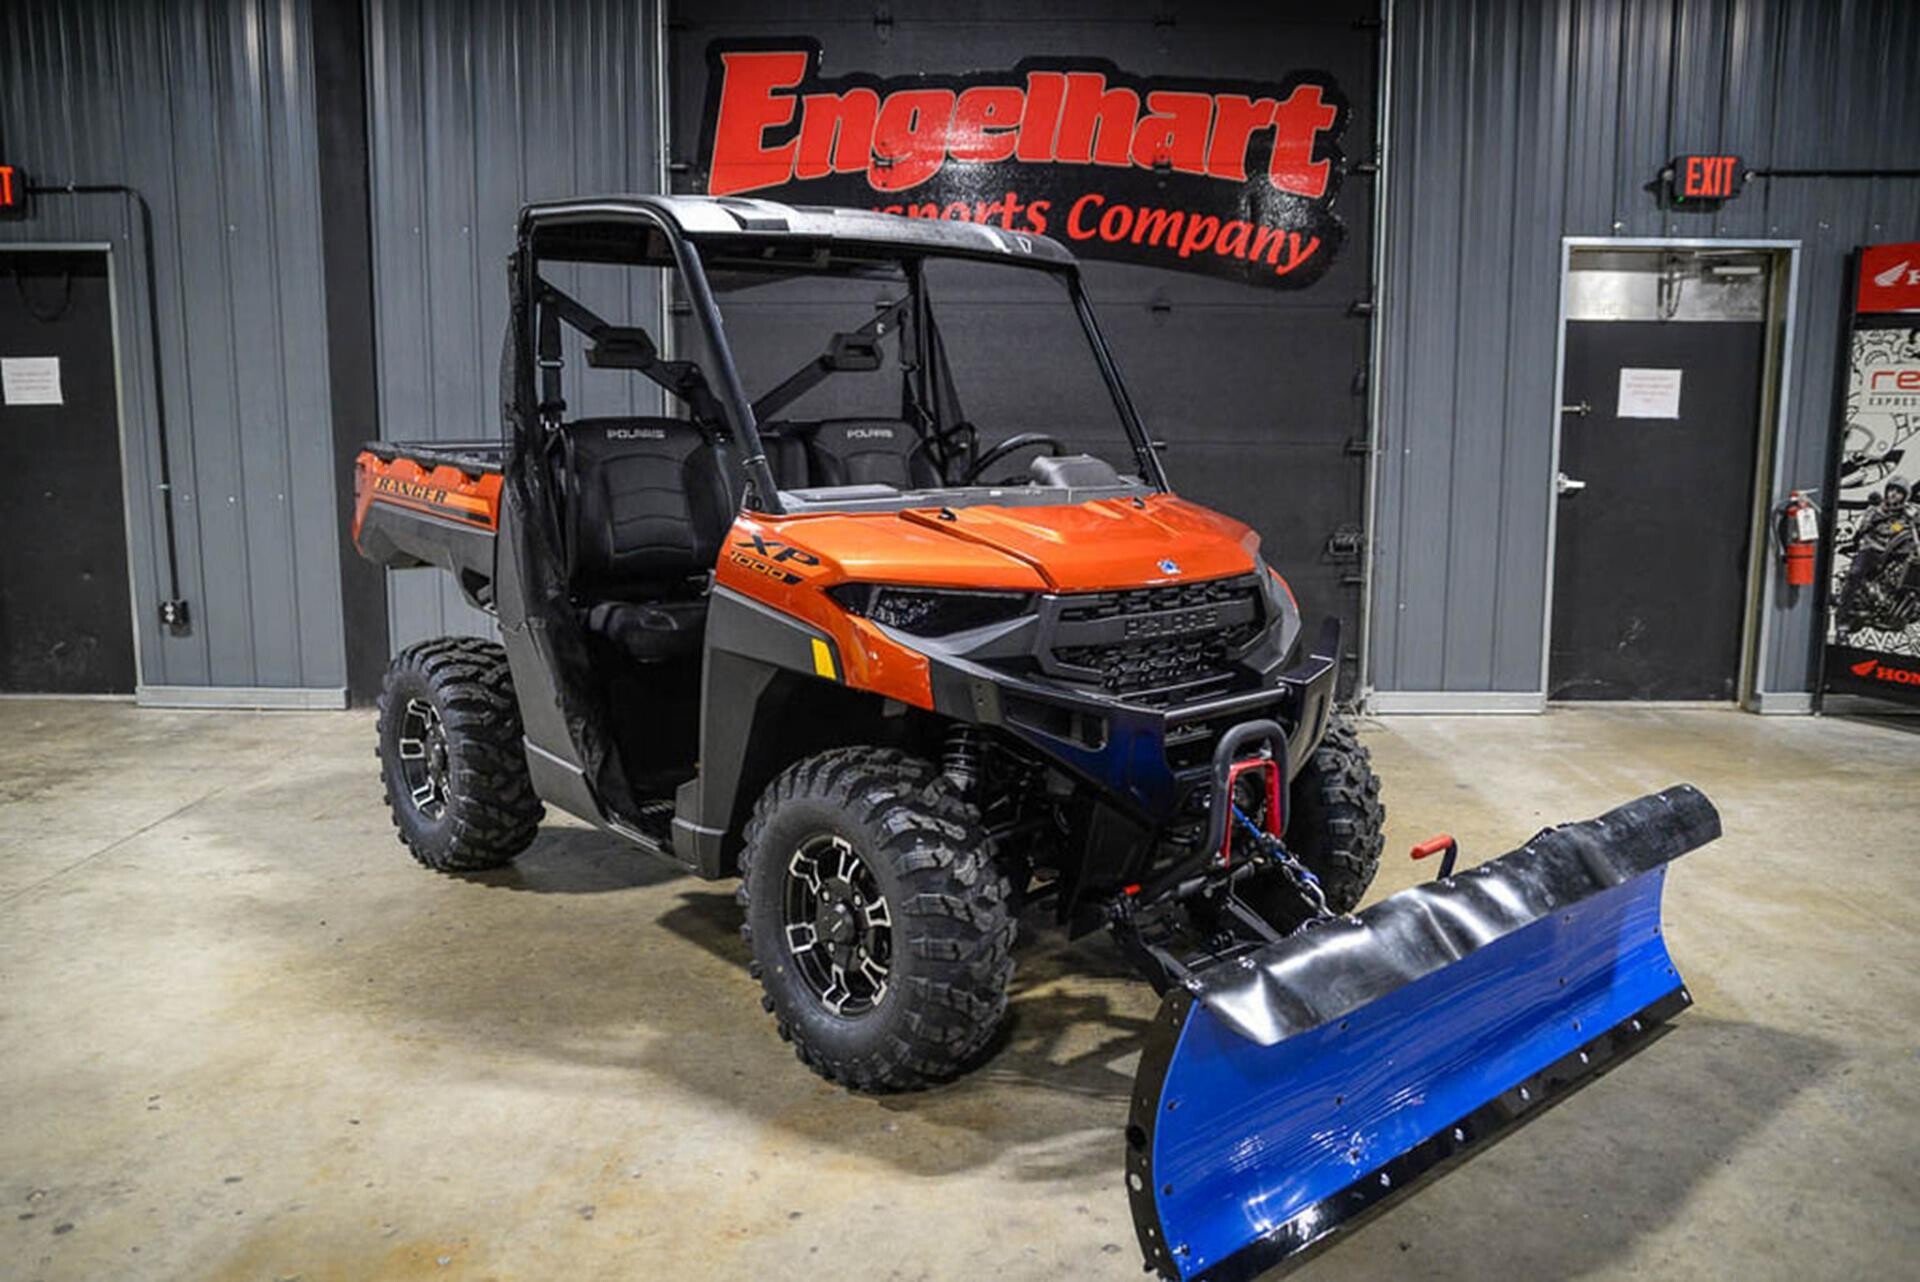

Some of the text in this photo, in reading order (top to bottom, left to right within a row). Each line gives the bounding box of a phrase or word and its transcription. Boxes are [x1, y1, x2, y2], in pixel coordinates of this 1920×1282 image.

[708, 51, 1337, 199] Engelhart
[1685, 156, 1736, 196] EXIT
[1066, 193, 1320, 275] Company
[377, 478, 448, 504] RANGER
[730, 550, 787, 581] 1000
[735, 533, 820, 566] XP
